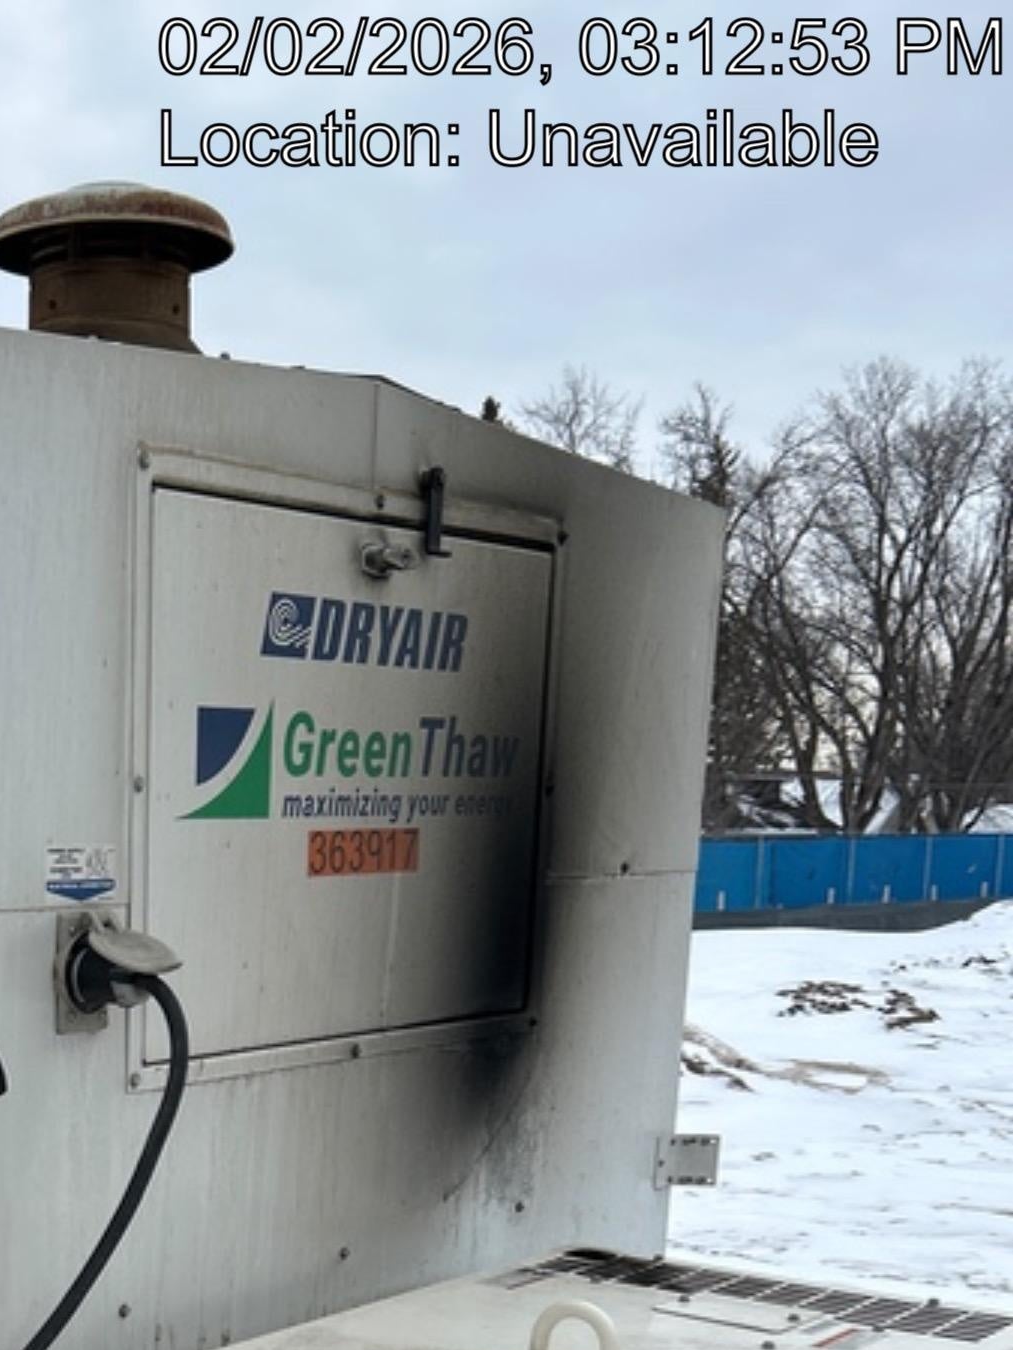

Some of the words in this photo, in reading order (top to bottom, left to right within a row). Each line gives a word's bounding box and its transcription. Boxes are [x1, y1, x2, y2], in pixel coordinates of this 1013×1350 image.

[310, 598, 469, 673] DRYAIR
[280, 787, 401, 823] maximizing
[405, 794, 450, 823] your
[308, 829, 420, 876] 363917
